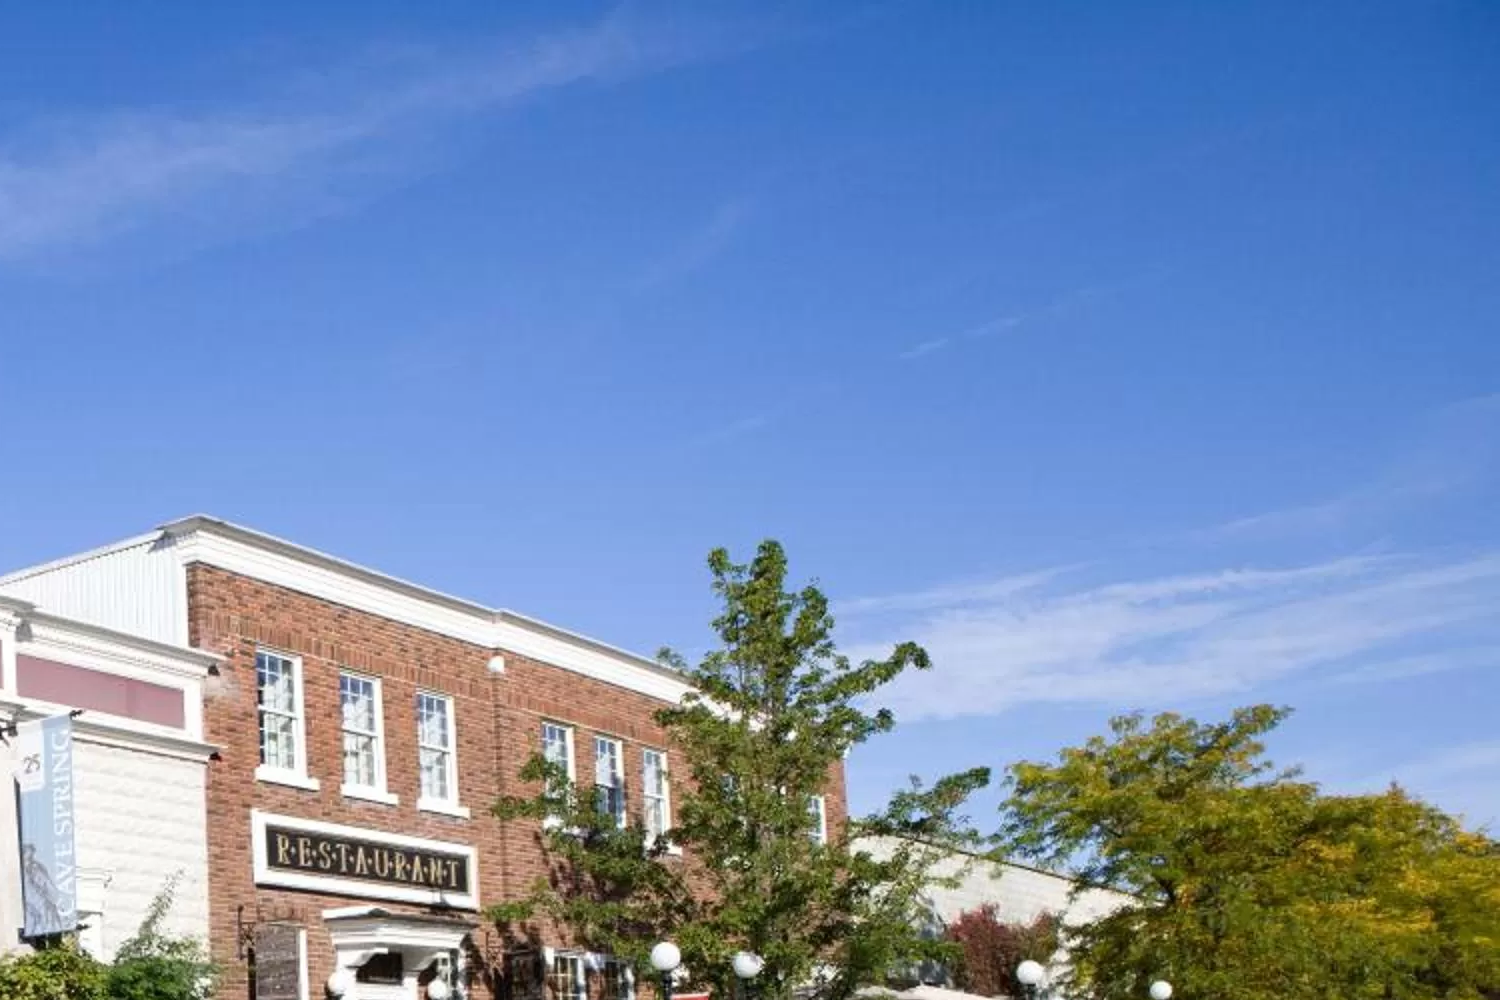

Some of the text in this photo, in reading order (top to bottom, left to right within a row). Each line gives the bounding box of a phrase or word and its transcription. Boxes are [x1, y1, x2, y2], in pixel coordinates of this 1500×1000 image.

[24, 753, 40, 774] 25
[51, 729, 75, 917] CAVE SPRING
